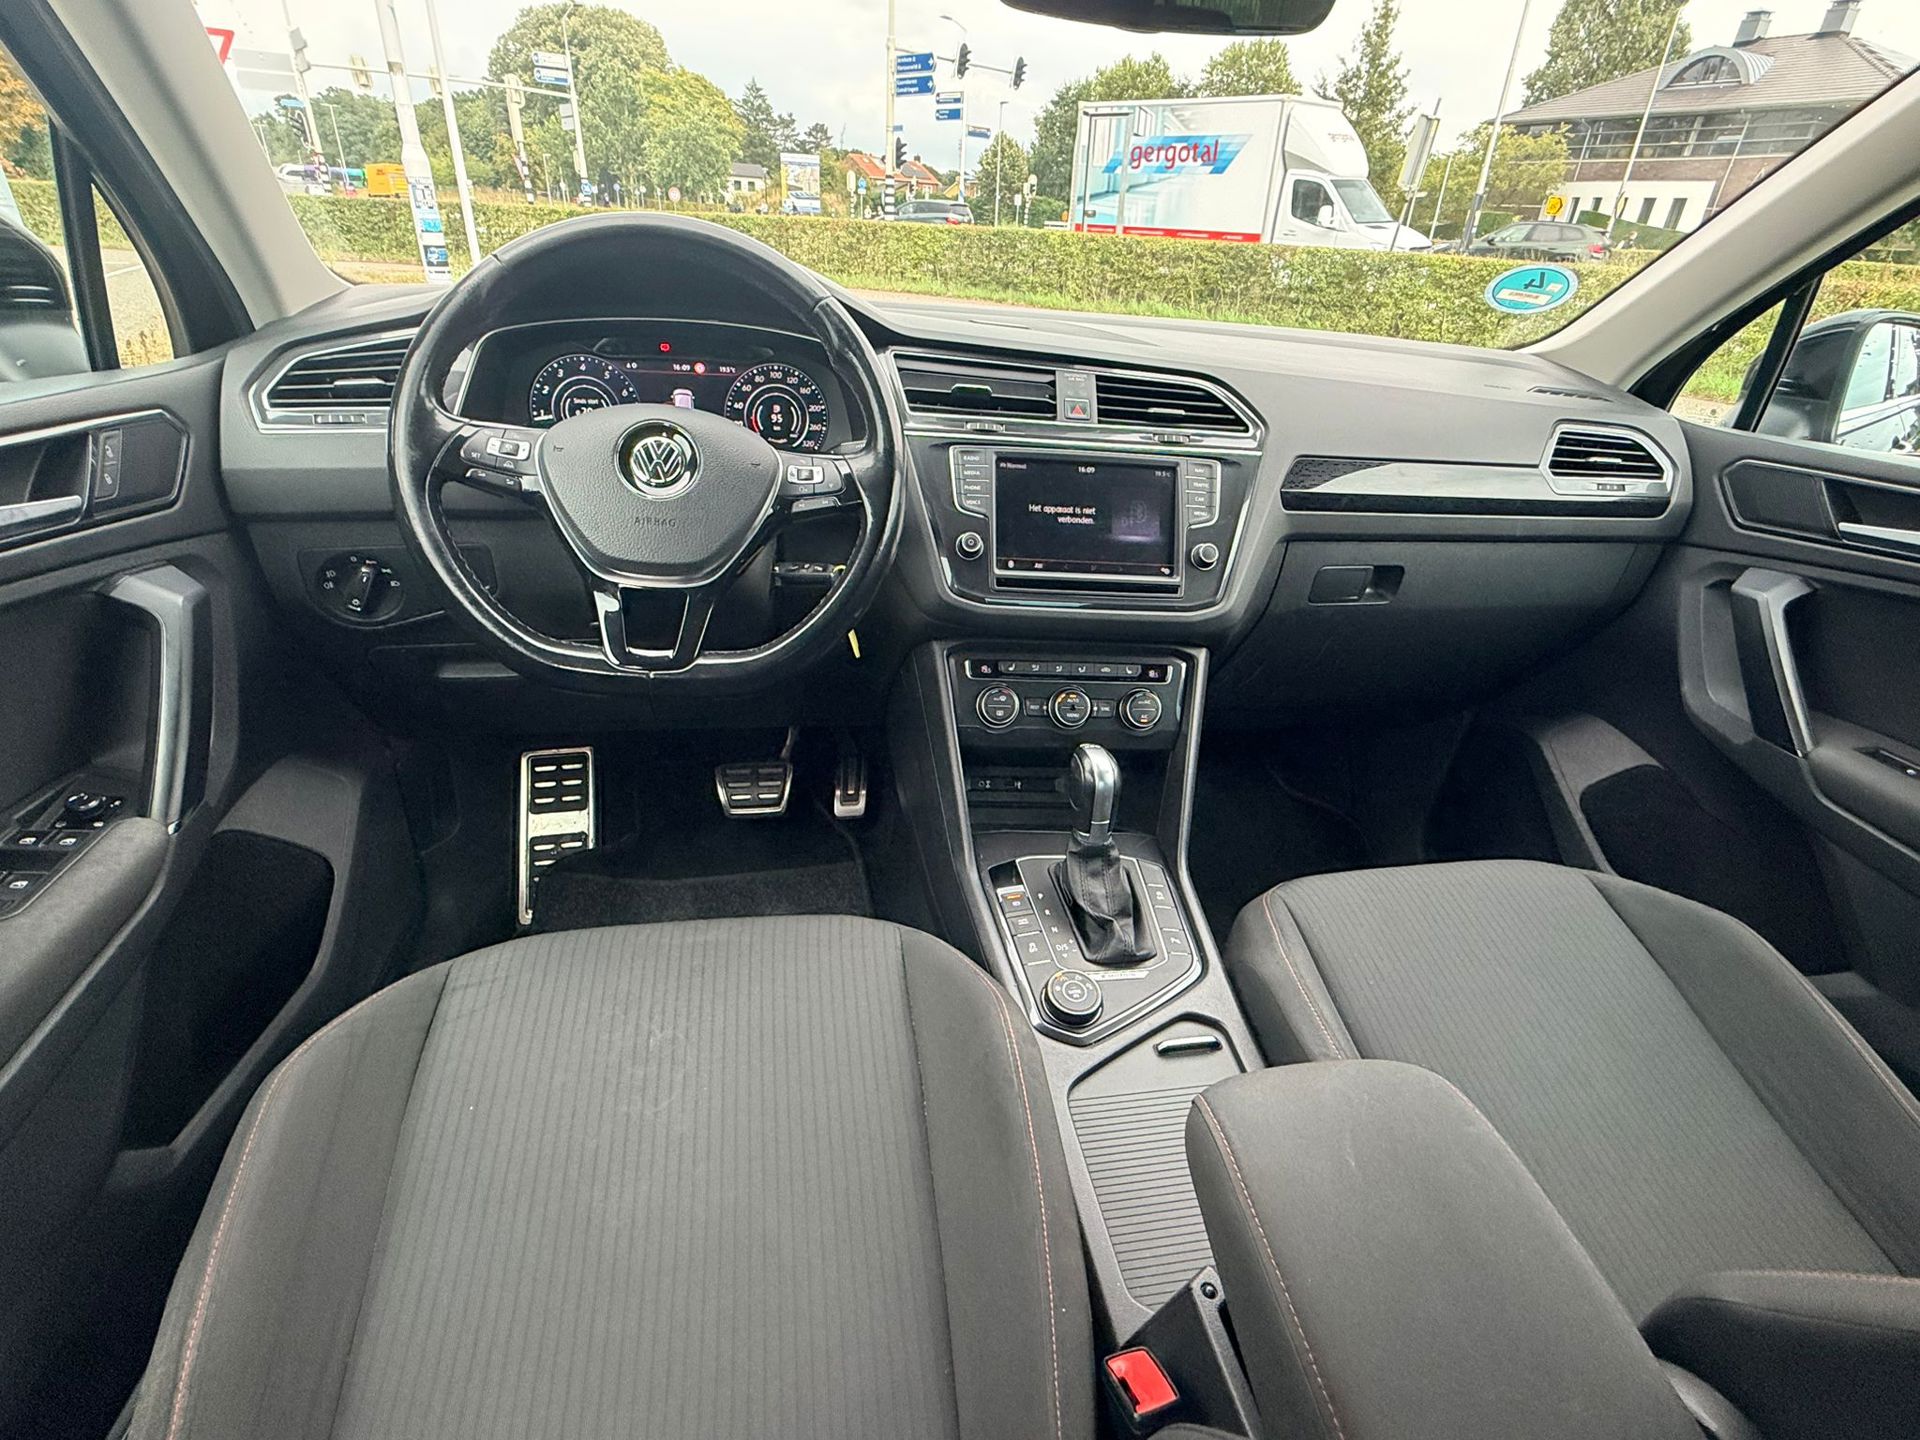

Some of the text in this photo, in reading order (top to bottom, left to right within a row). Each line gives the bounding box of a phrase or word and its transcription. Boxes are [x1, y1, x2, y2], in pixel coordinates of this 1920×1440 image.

[1130, 139, 1219, 170] gergotal
[557, 369, 564, 377] 3
[604, 370, 610, 379] 5
[769, 371, 783, 379] 100
[754, 375, 765, 383] 80
[541, 385, 550, 394] 2
[741, 384, 752, 392] 60
[800, 387, 811, 395] 160
[621, 388, 629, 397] 6
[733, 401, 744, 410] 40
[808, 404, 821, 412] 200
[770, 414, 783, 423] 95
[809, 423, 822, 431] 260
[1028, 504, 1096, 515] Het apparaat is niet
[634, 516, 676, 527] AIRBAG
[1057, 516, 1095, 524] verbonden.
[1055, 943, 1069, 951] D/S
